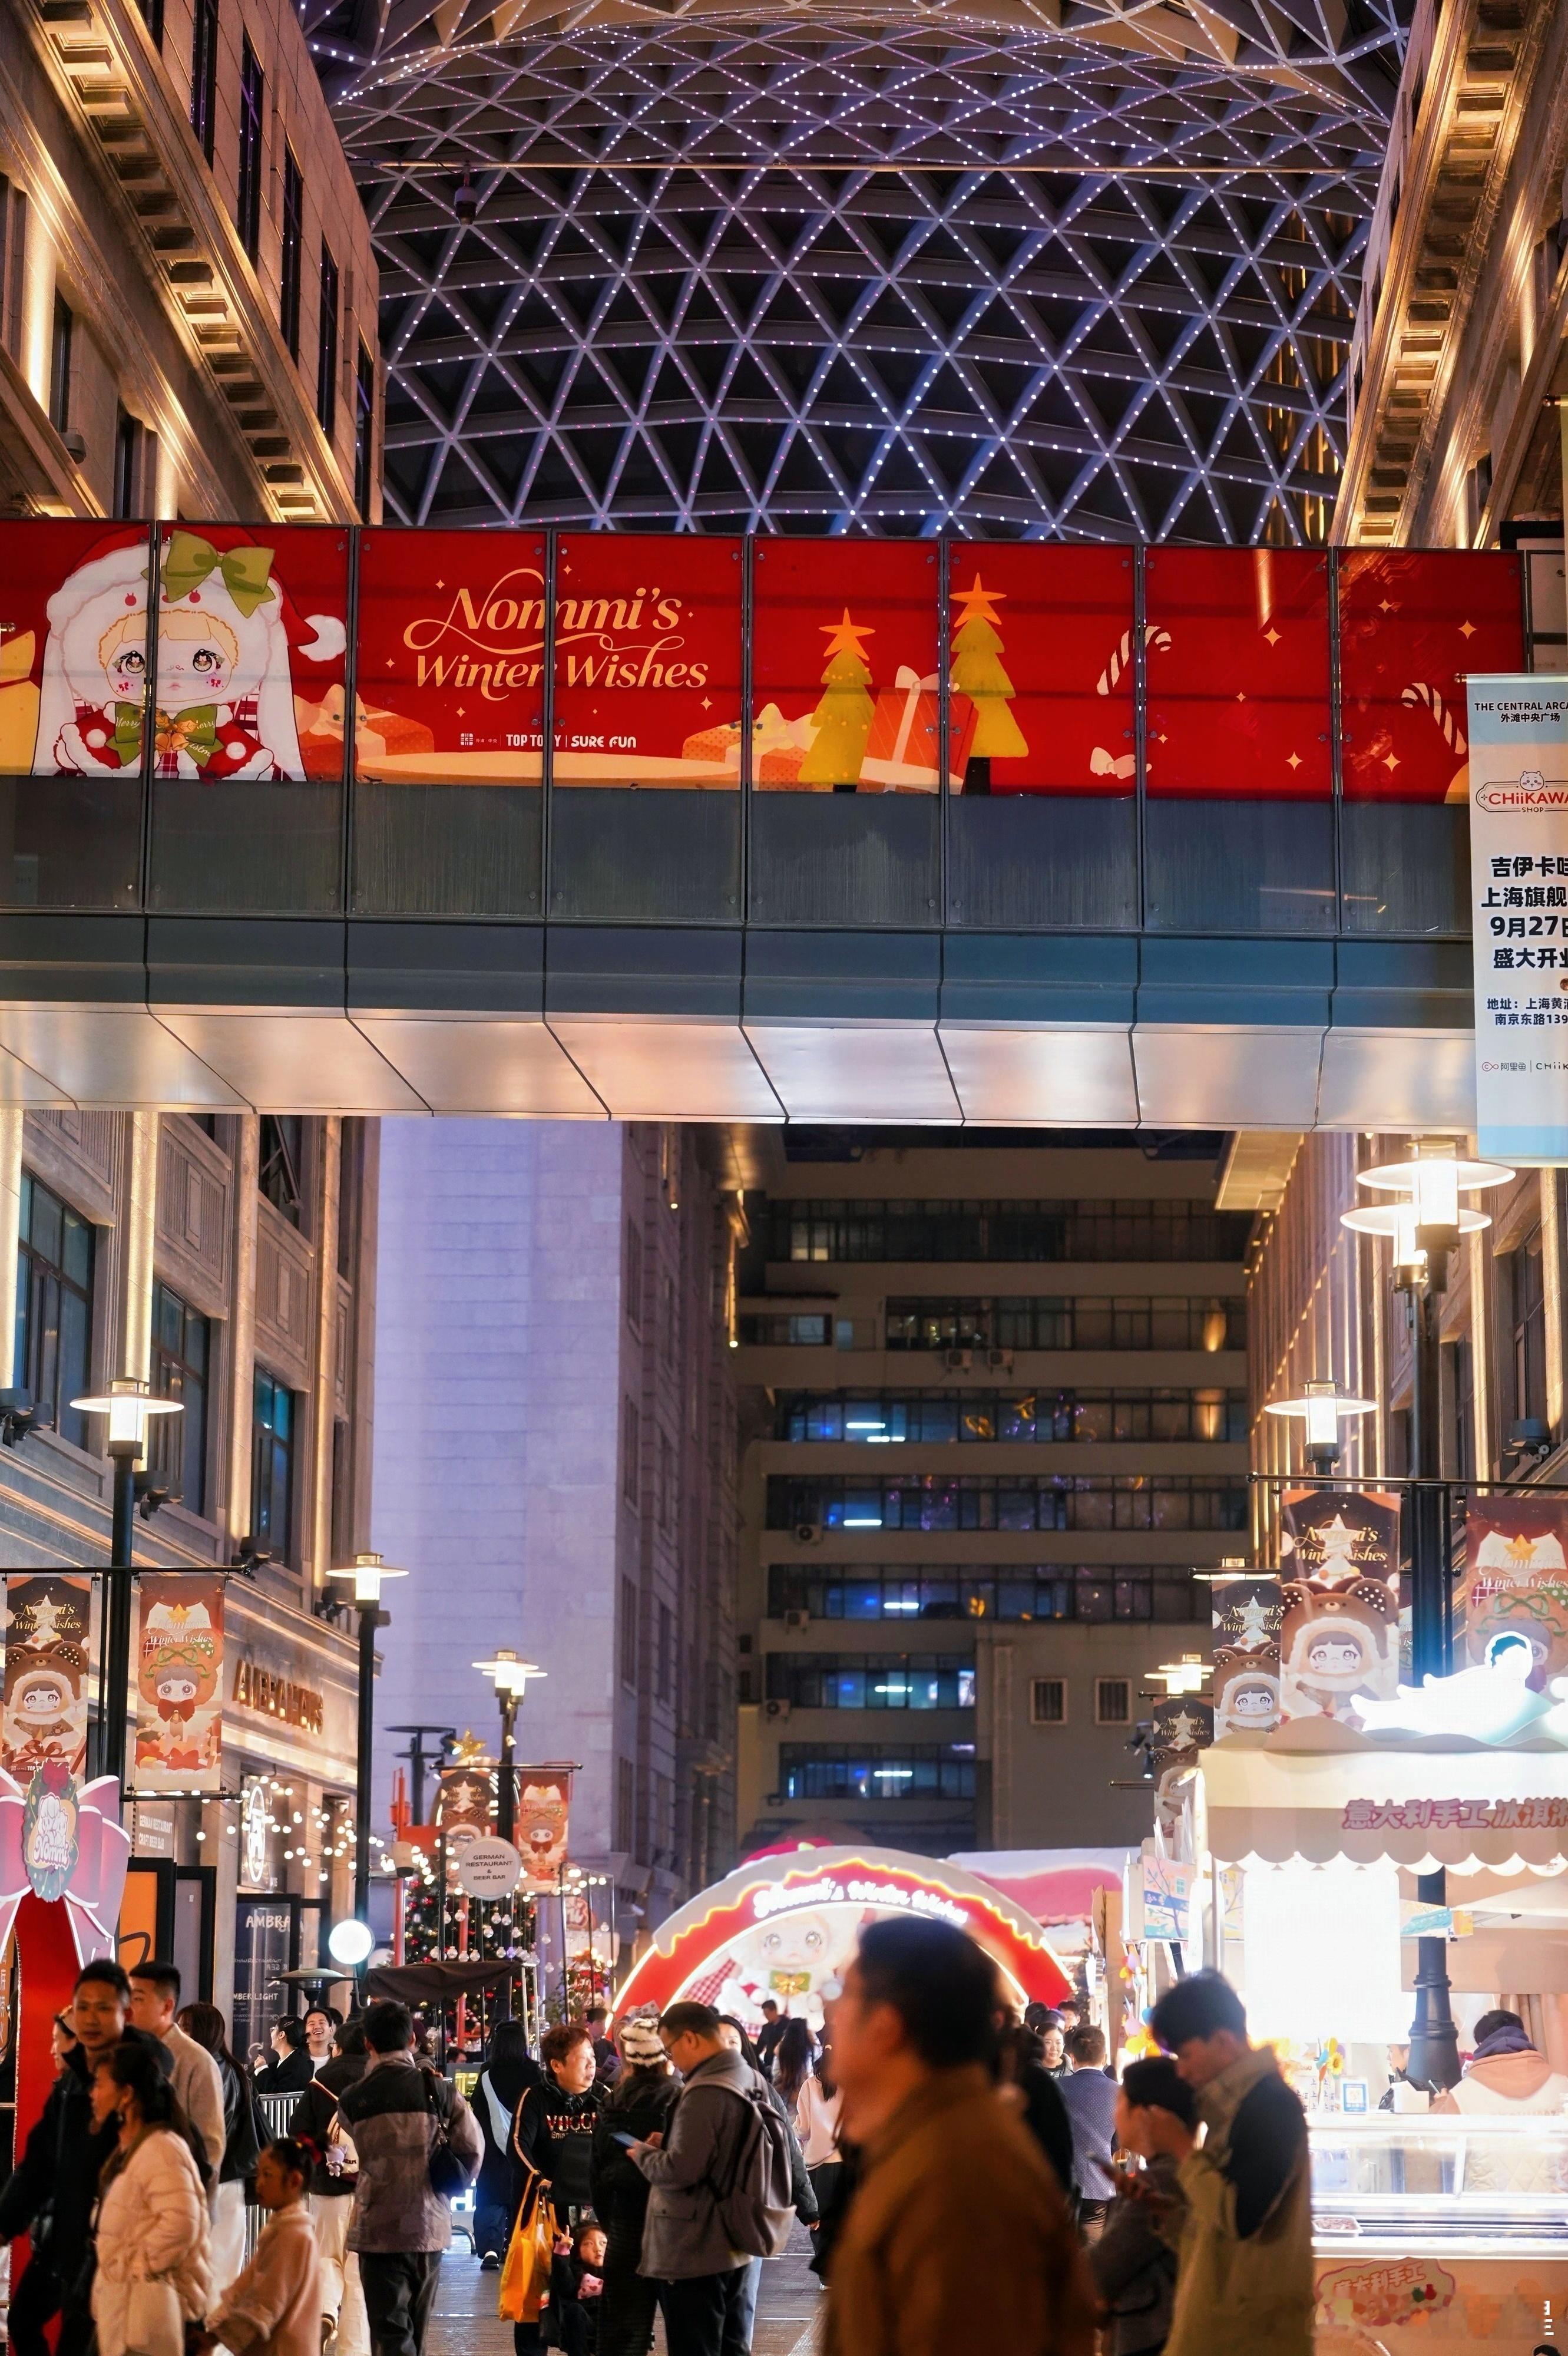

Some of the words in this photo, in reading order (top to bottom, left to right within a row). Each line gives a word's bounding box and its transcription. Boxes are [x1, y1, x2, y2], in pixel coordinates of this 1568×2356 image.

[417, 655, 556, 701] Winter
[567, 636, 709, 688] Wishes
[1497, 702, 1543, 711] CENTRAL
[1501, 713, 1560, 722] 外滩中央广场
[506, 734, 528, 746] TOP
[571, 735, 604, 748] SURE
[609, 736, 637, 748] FUN
[1481, 887, 1567, 907] 上海旗舰
[1501, 1062, 1526, 1071] 阿里鱼
[1296, 1549, 1335, 1564] Winte
[16, 1621, 44, 1633] Winte
